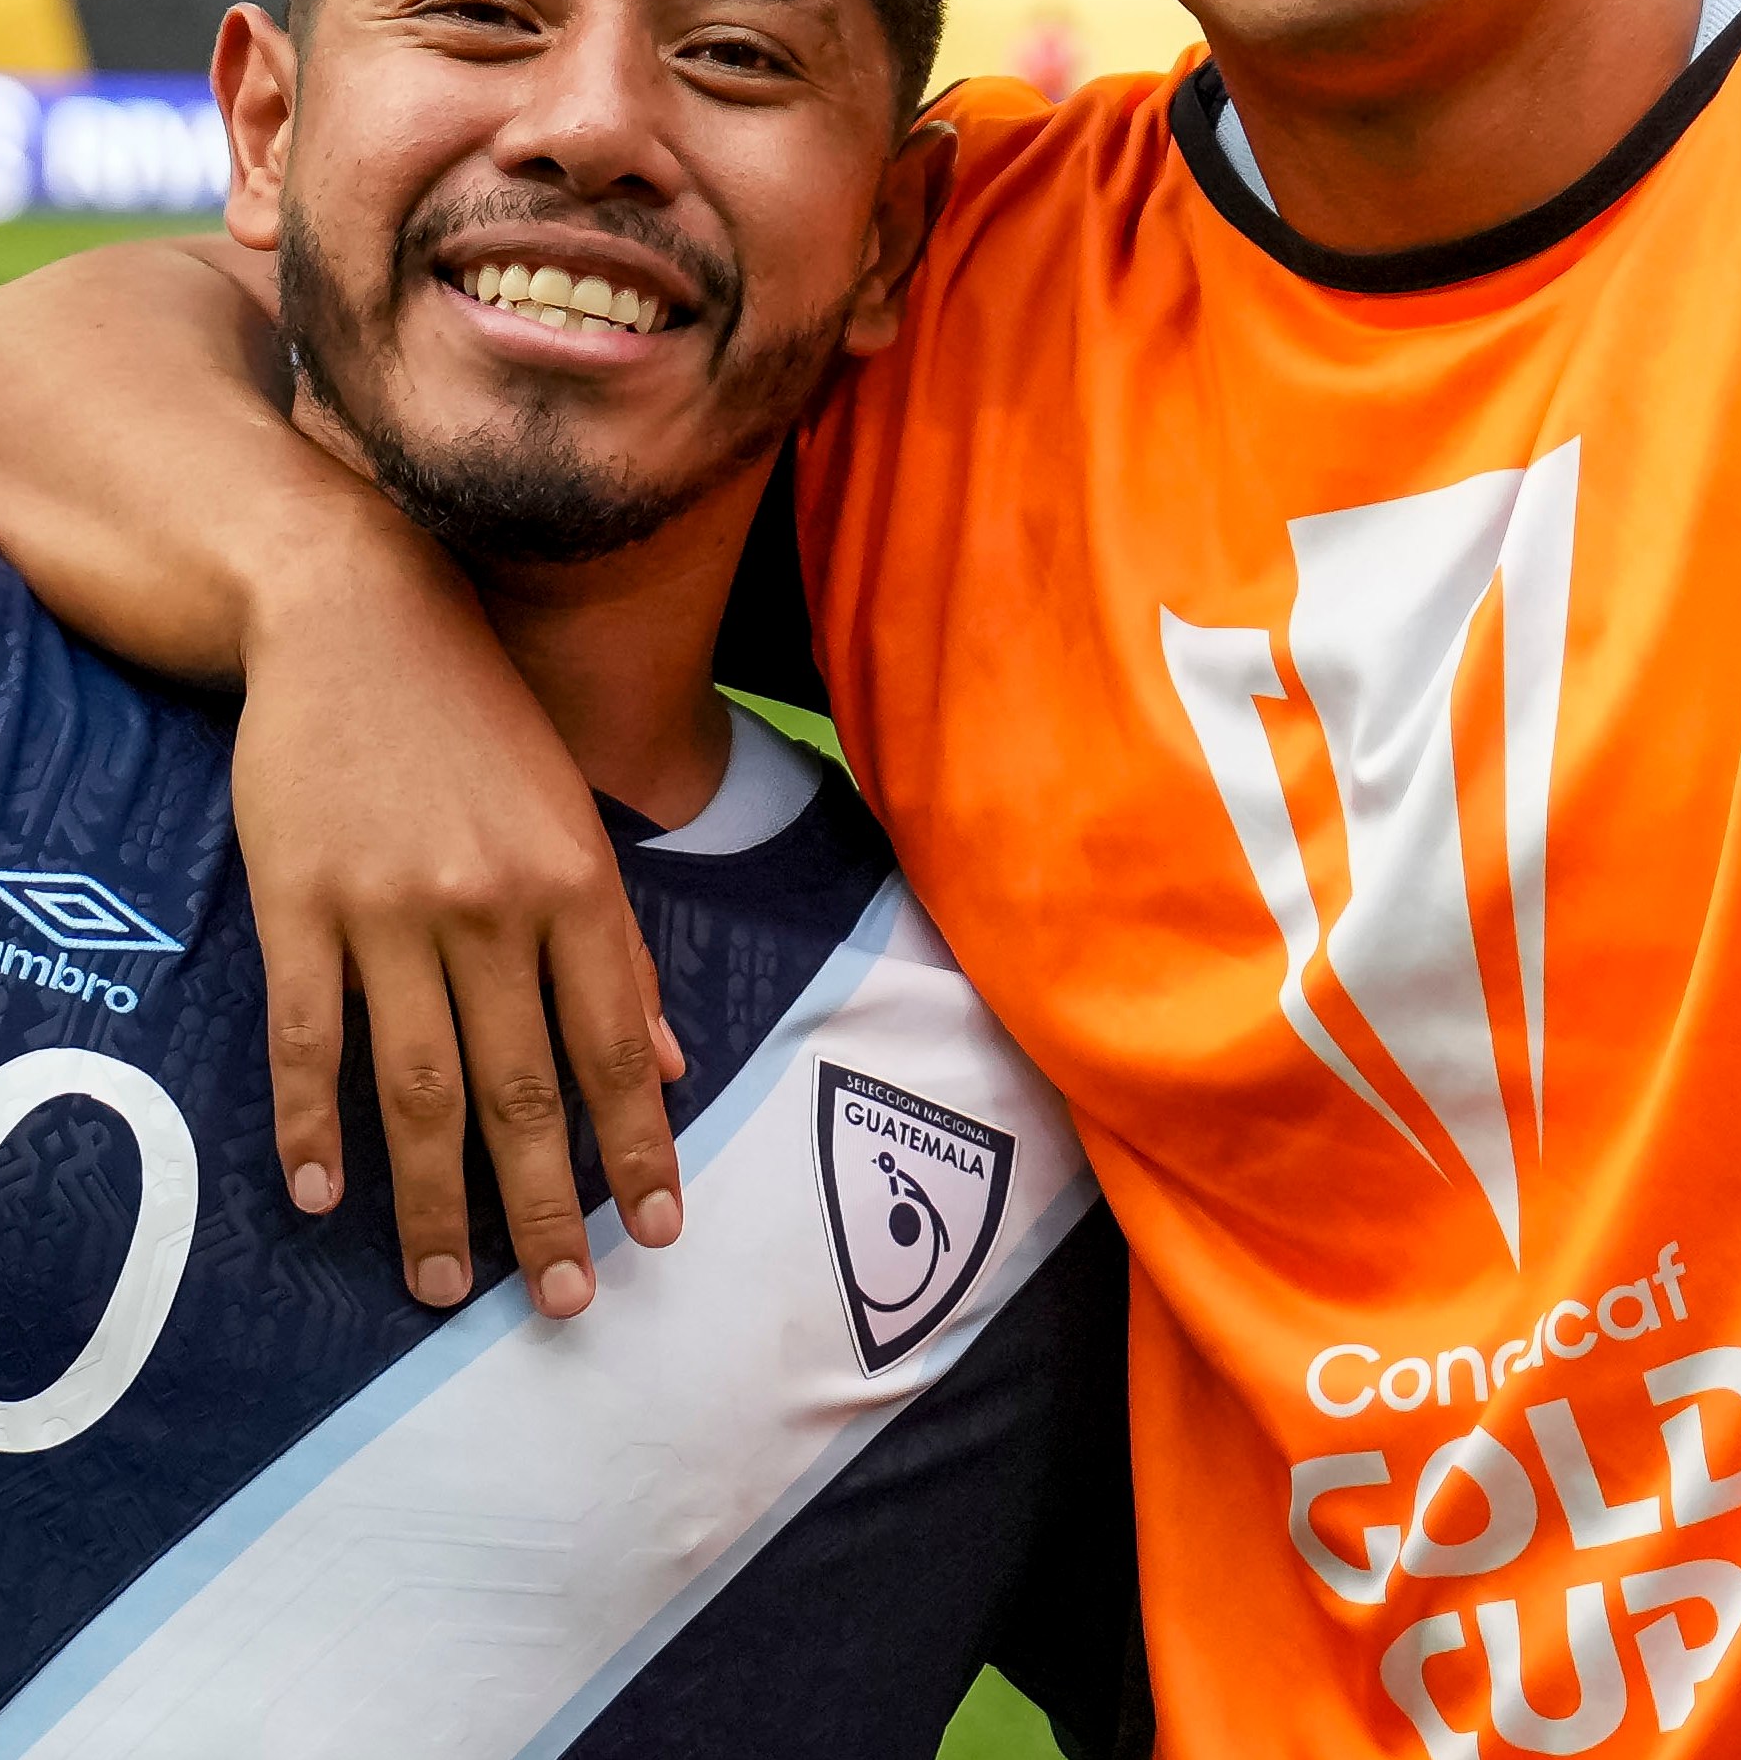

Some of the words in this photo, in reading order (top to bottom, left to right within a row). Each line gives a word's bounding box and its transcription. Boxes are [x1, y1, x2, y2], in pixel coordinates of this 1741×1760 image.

[844, 1101, 985, 1181] GUATEMALA
[846, 1074, 920, 1115] SELECCION
[923, 1106, 992, 1146] NACIONAL
